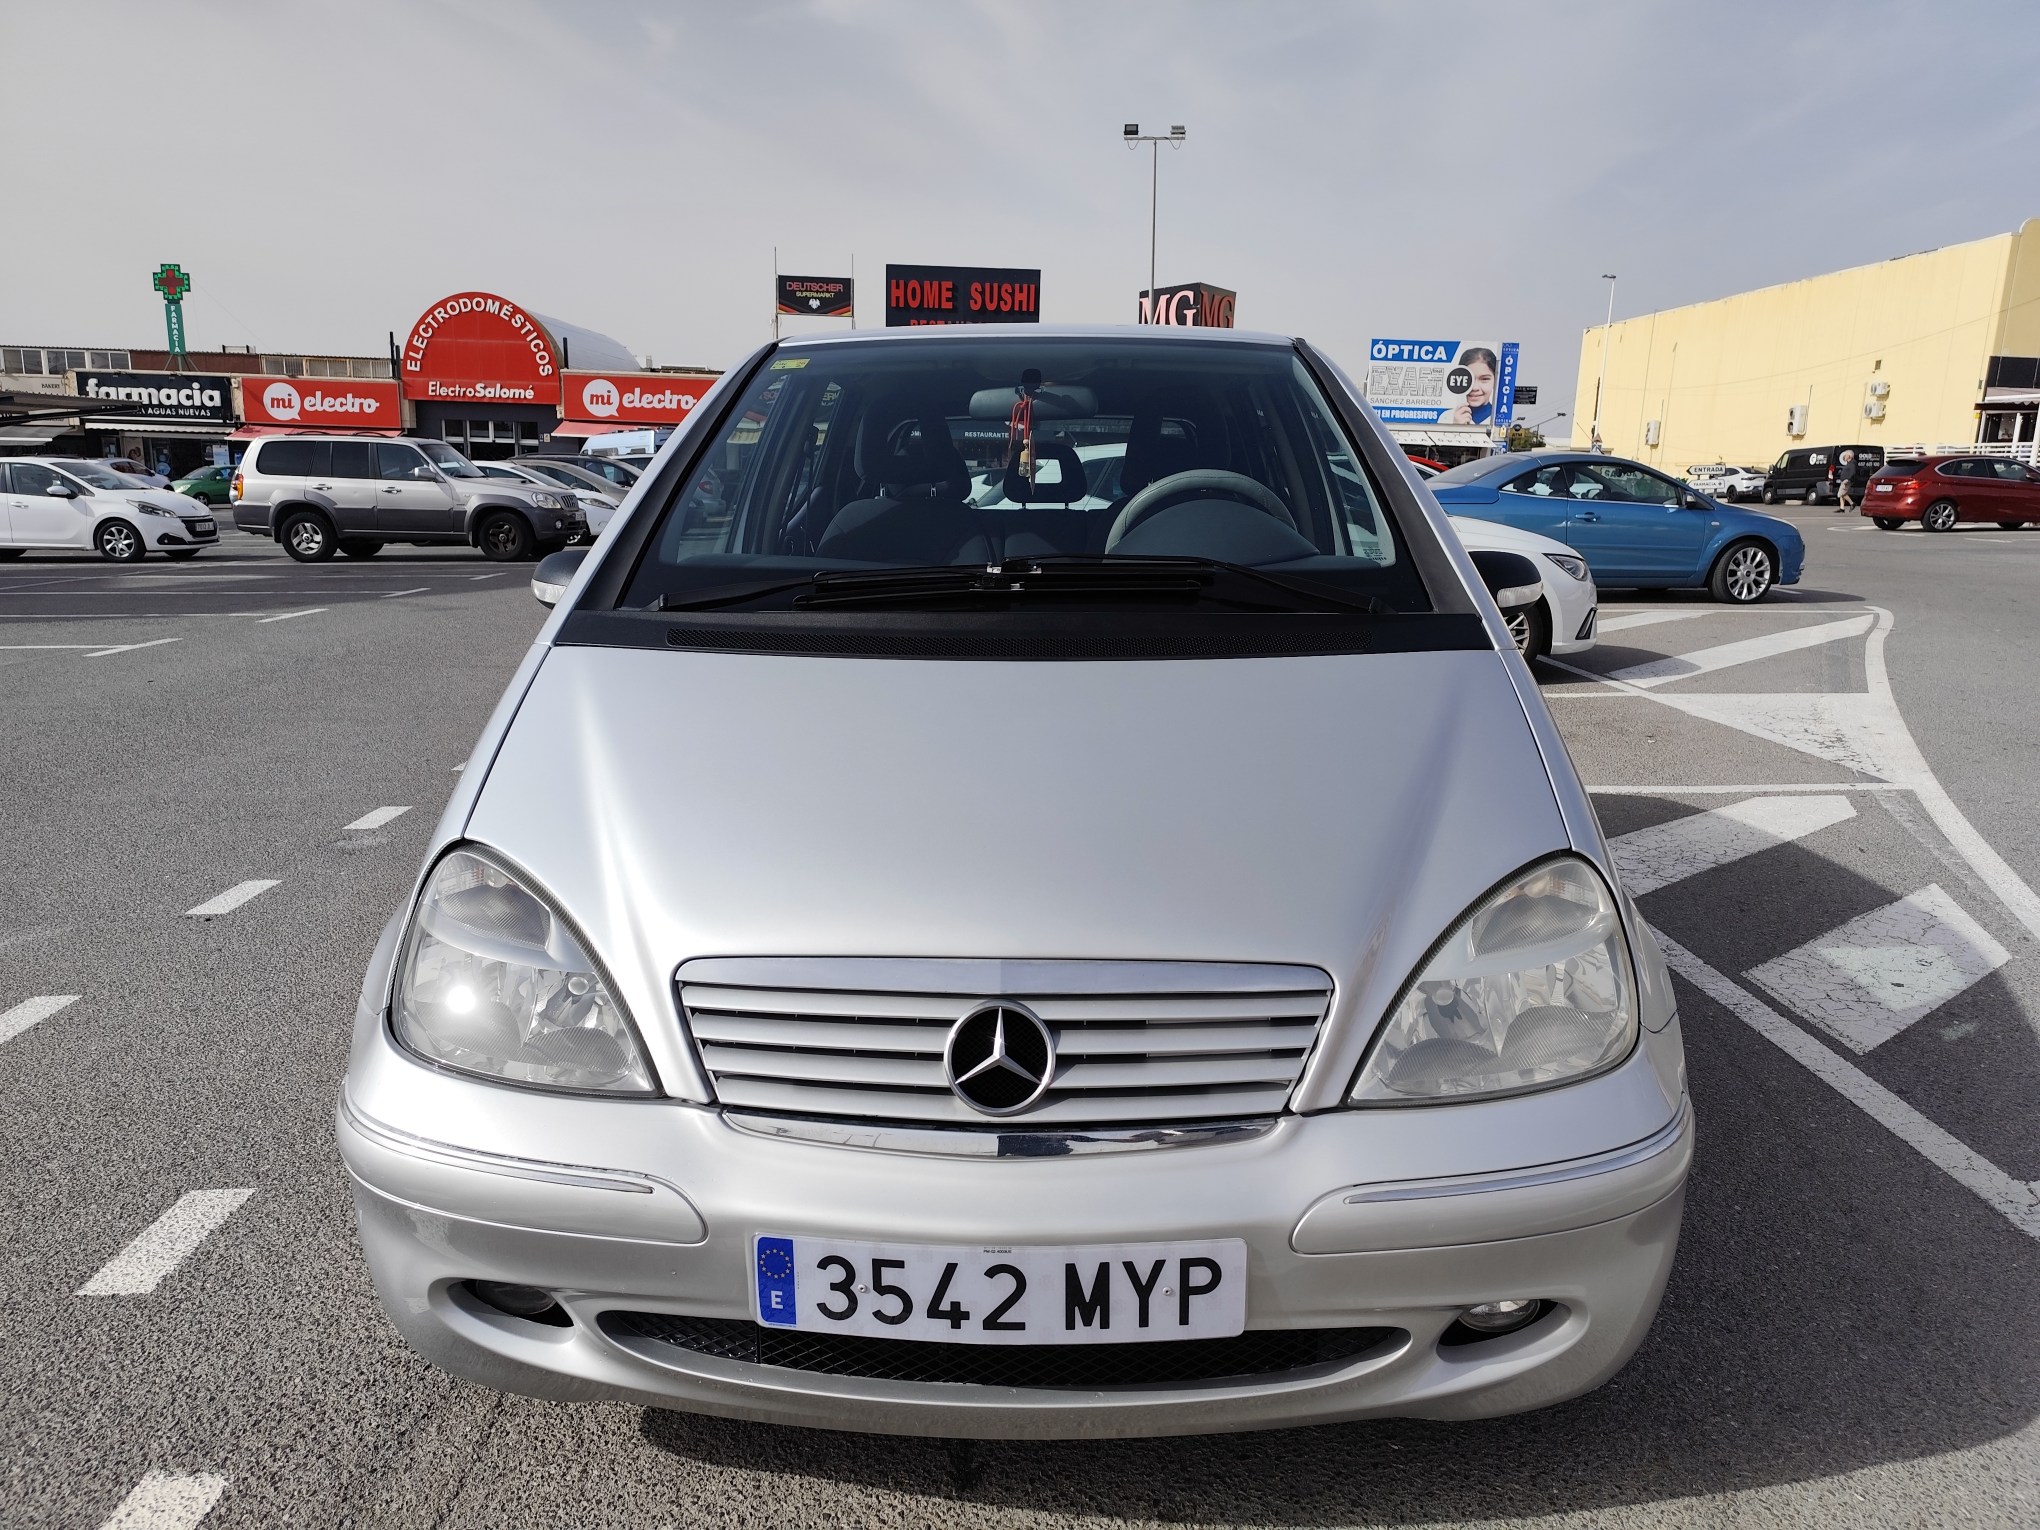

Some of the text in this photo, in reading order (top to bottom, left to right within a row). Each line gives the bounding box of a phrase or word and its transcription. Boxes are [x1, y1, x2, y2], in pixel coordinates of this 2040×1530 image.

[786, 281, 844, 292] DEUTSCHER
[890, 279, 1036, 312] HOME SUSHI
[1139, 290, 1197, 327] MG
[1200, 289, 1234, 328] MG
[170, 305, 181, 353] FARMACIA
[407, 297, 553, 377] ELECTRODOMÉSTICOS
[1372, 341, 1448, 361] ÓPTICA
[428, 381, 535, 399] ElectroSalomé
[1449, 375, 1469, 387] EYE
[86, 377, 222, 407] farmacia
[270, 390, 380, 414] mi electro
[589, 387, 698, 410] mi electro
[1406, 398, 1442, 406] BARREDO
[147, 407, 176, 416] AGUAS
[178, 408, 211, 417] NUEVAS
[1381, 409, 1391, 418] EN
[1391, 409, 1438, 420] PROGRESIVOS
[964, 431, 1009, 439] RESTAURANTE
[771, 1290, 784, 1310] E
[816, 1254, 1223, 1331] 3542 MYP
